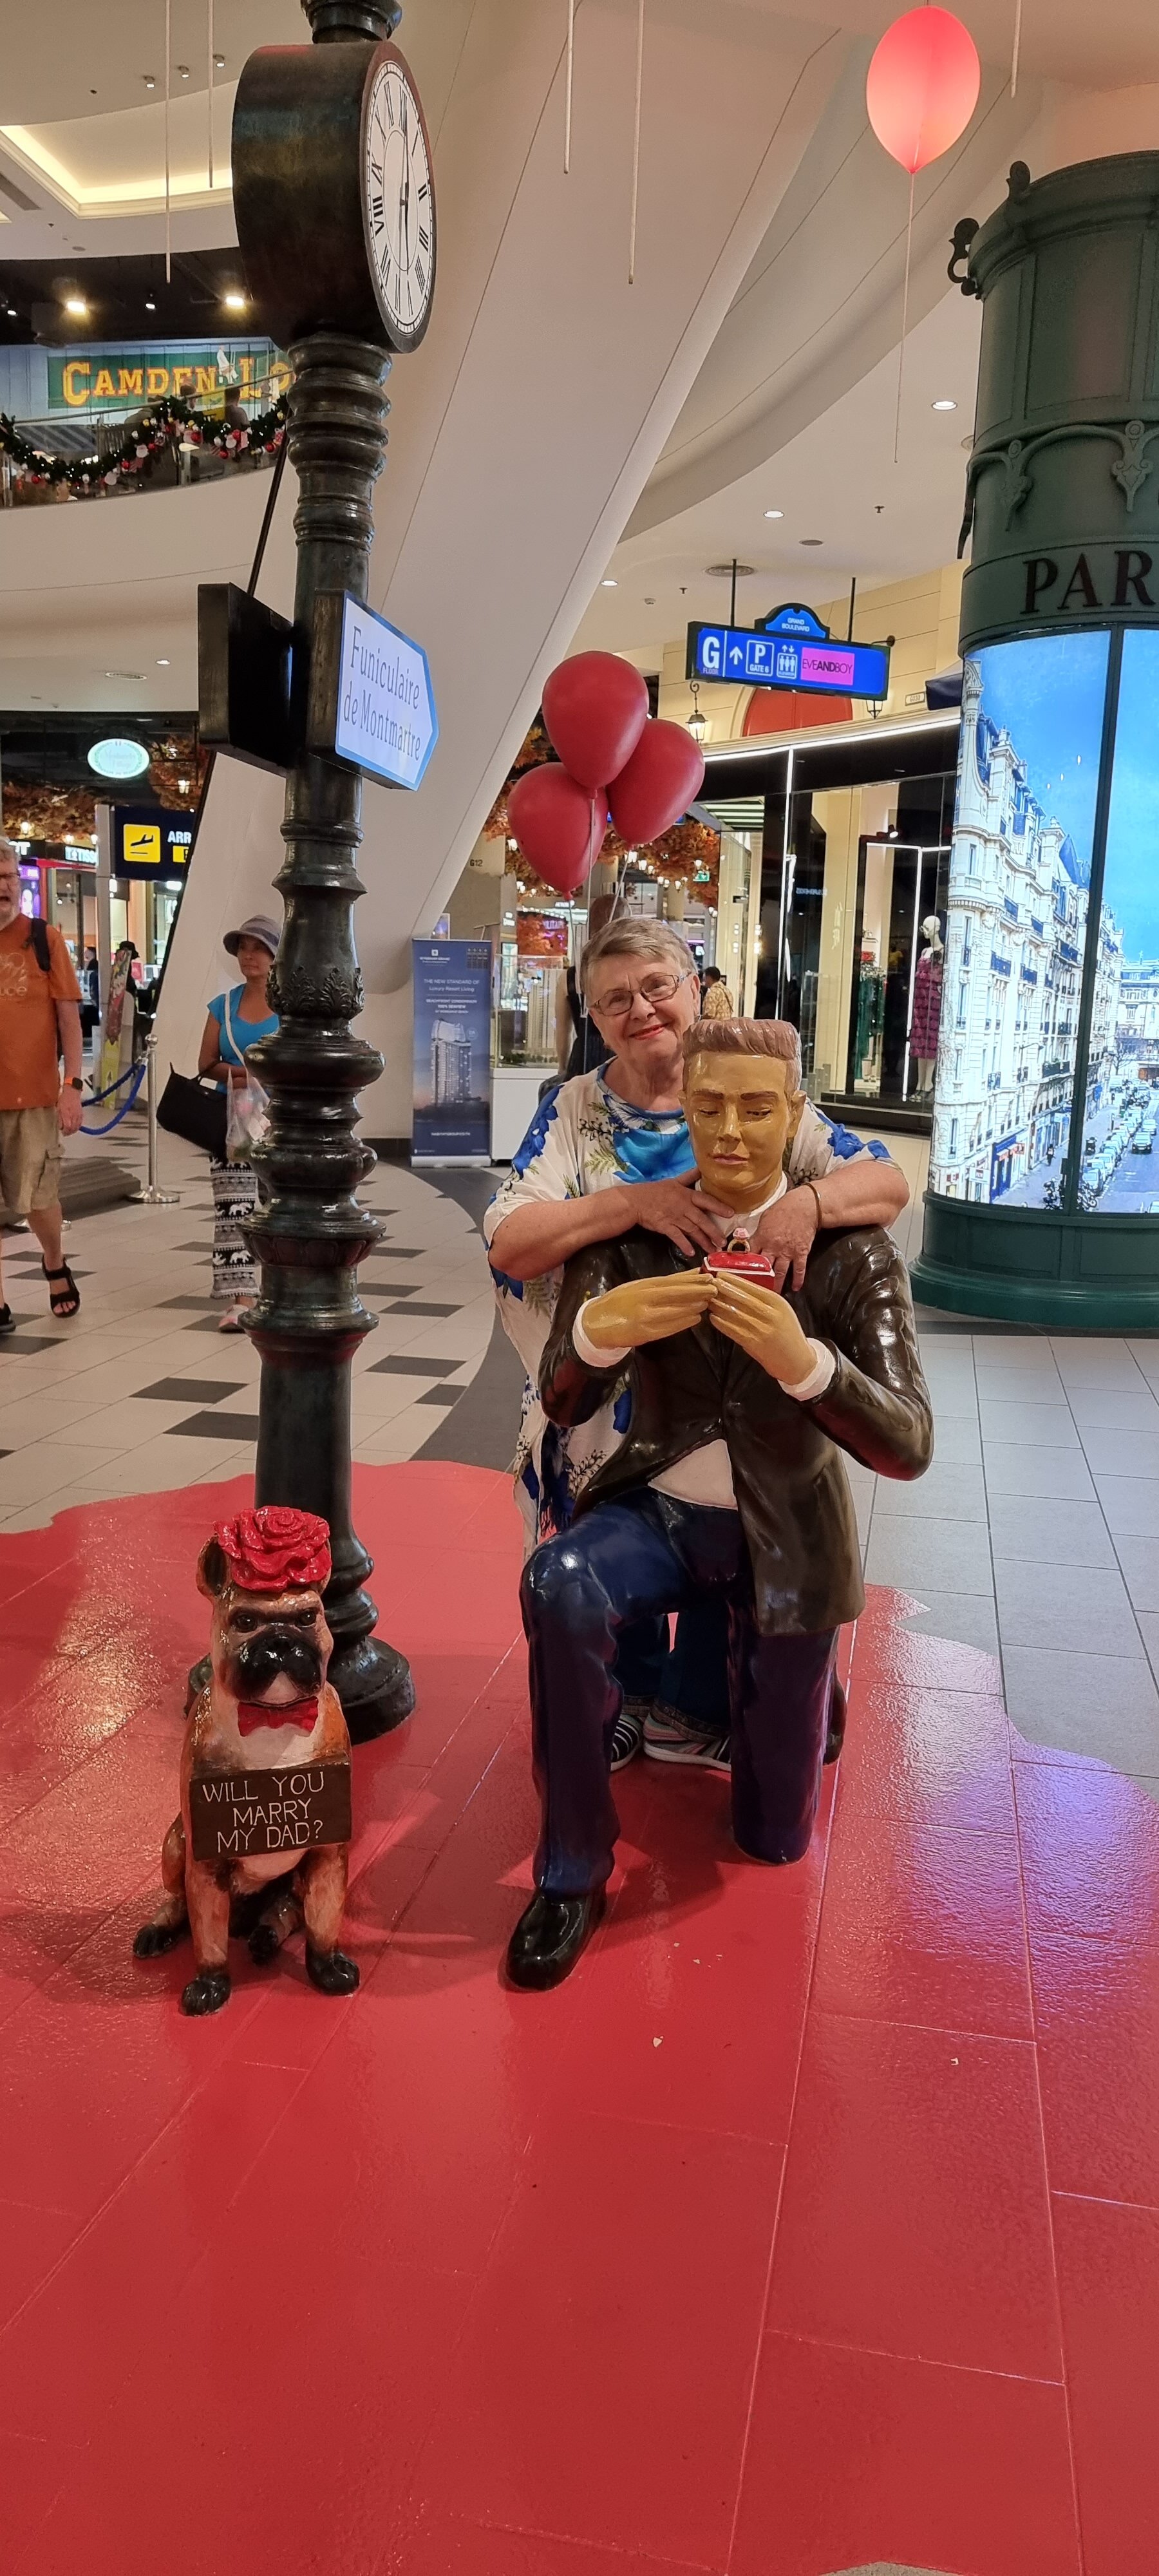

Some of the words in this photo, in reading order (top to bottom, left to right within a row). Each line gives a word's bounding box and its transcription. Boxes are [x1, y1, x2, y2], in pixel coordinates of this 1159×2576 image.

[62, 361, 218, 407] CAMDEN
[1020, 550, 1156, 614] PAR
[782, 623, 810, 632] BOULEVARD
[350, 625, 420, 710] Funiculaire
[702, 636, 720, 668] G
[754, 644, 766, 663] P
[802, 658, 853, 674] EVEANDBOY
[749, 663, 764, 673] GATE
[764, 665, 769, 674] 6
[343, 680, 358, 726] de
[361, 689, 421, 761] Montmartre
[167, 830, 192, 844] ARR
[202, 1780, 259, 1802] WILL
[272, 1771, 325, 1797] YOU
[233, 1798, 312, 1827] MARRY
[217, 1828, 255, 1853] MY
[267, 1819, 323, 1848] DAD?
